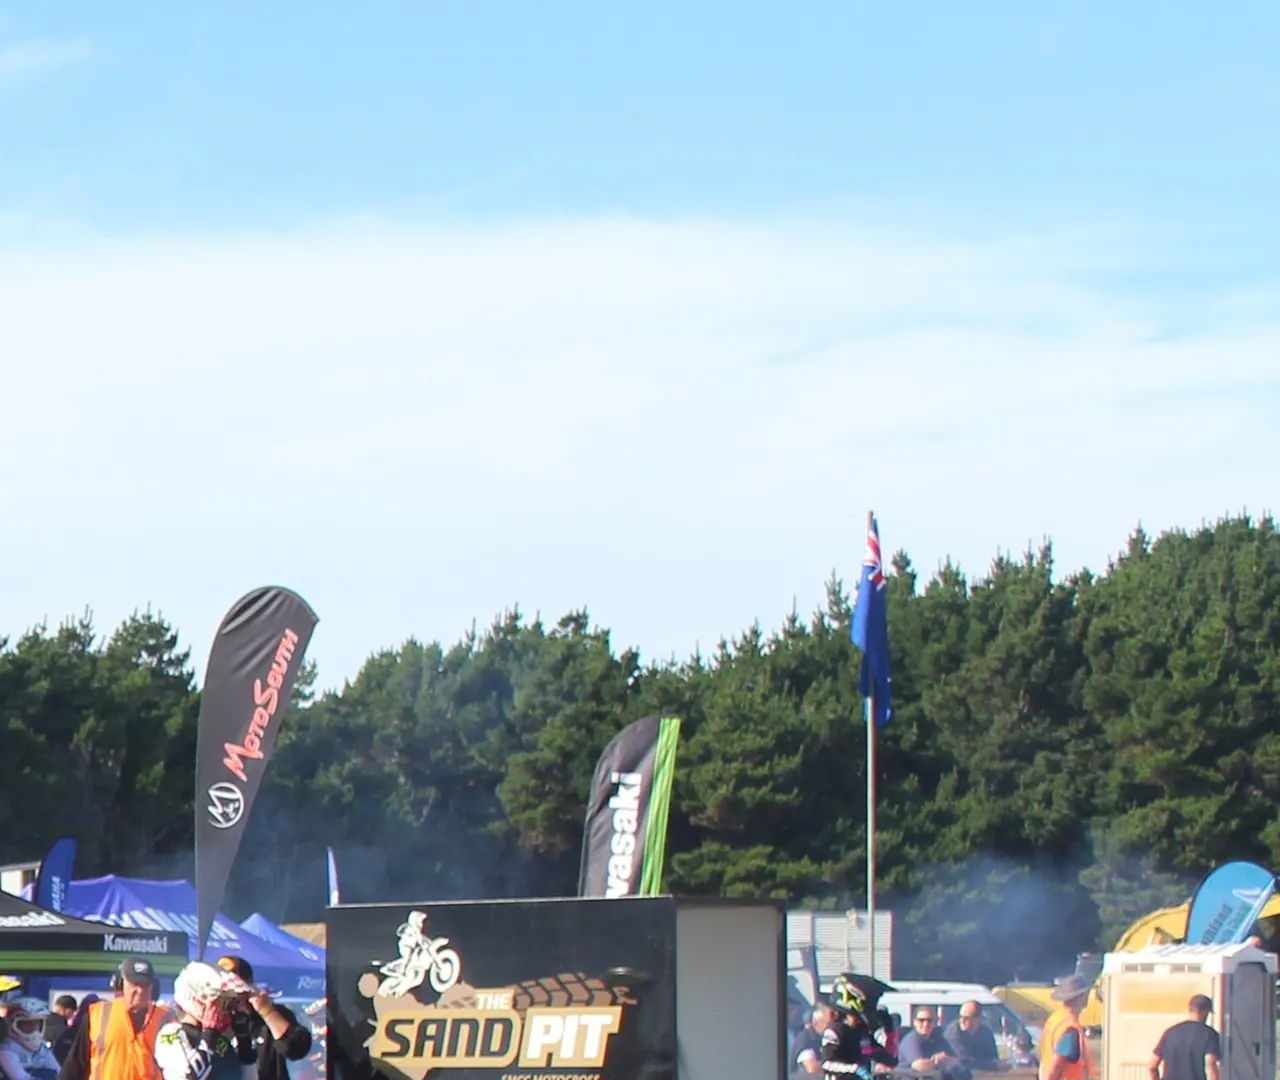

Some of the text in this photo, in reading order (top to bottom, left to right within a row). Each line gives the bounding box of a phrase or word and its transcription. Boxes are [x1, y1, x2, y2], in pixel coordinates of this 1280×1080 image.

[604, 771, 642, 899] wasaki
[103, 934, 168, 953] Kawasaki
[476, 992, 512, 1010] THE
[381, 1013, 613, 1060] SAND PIT
